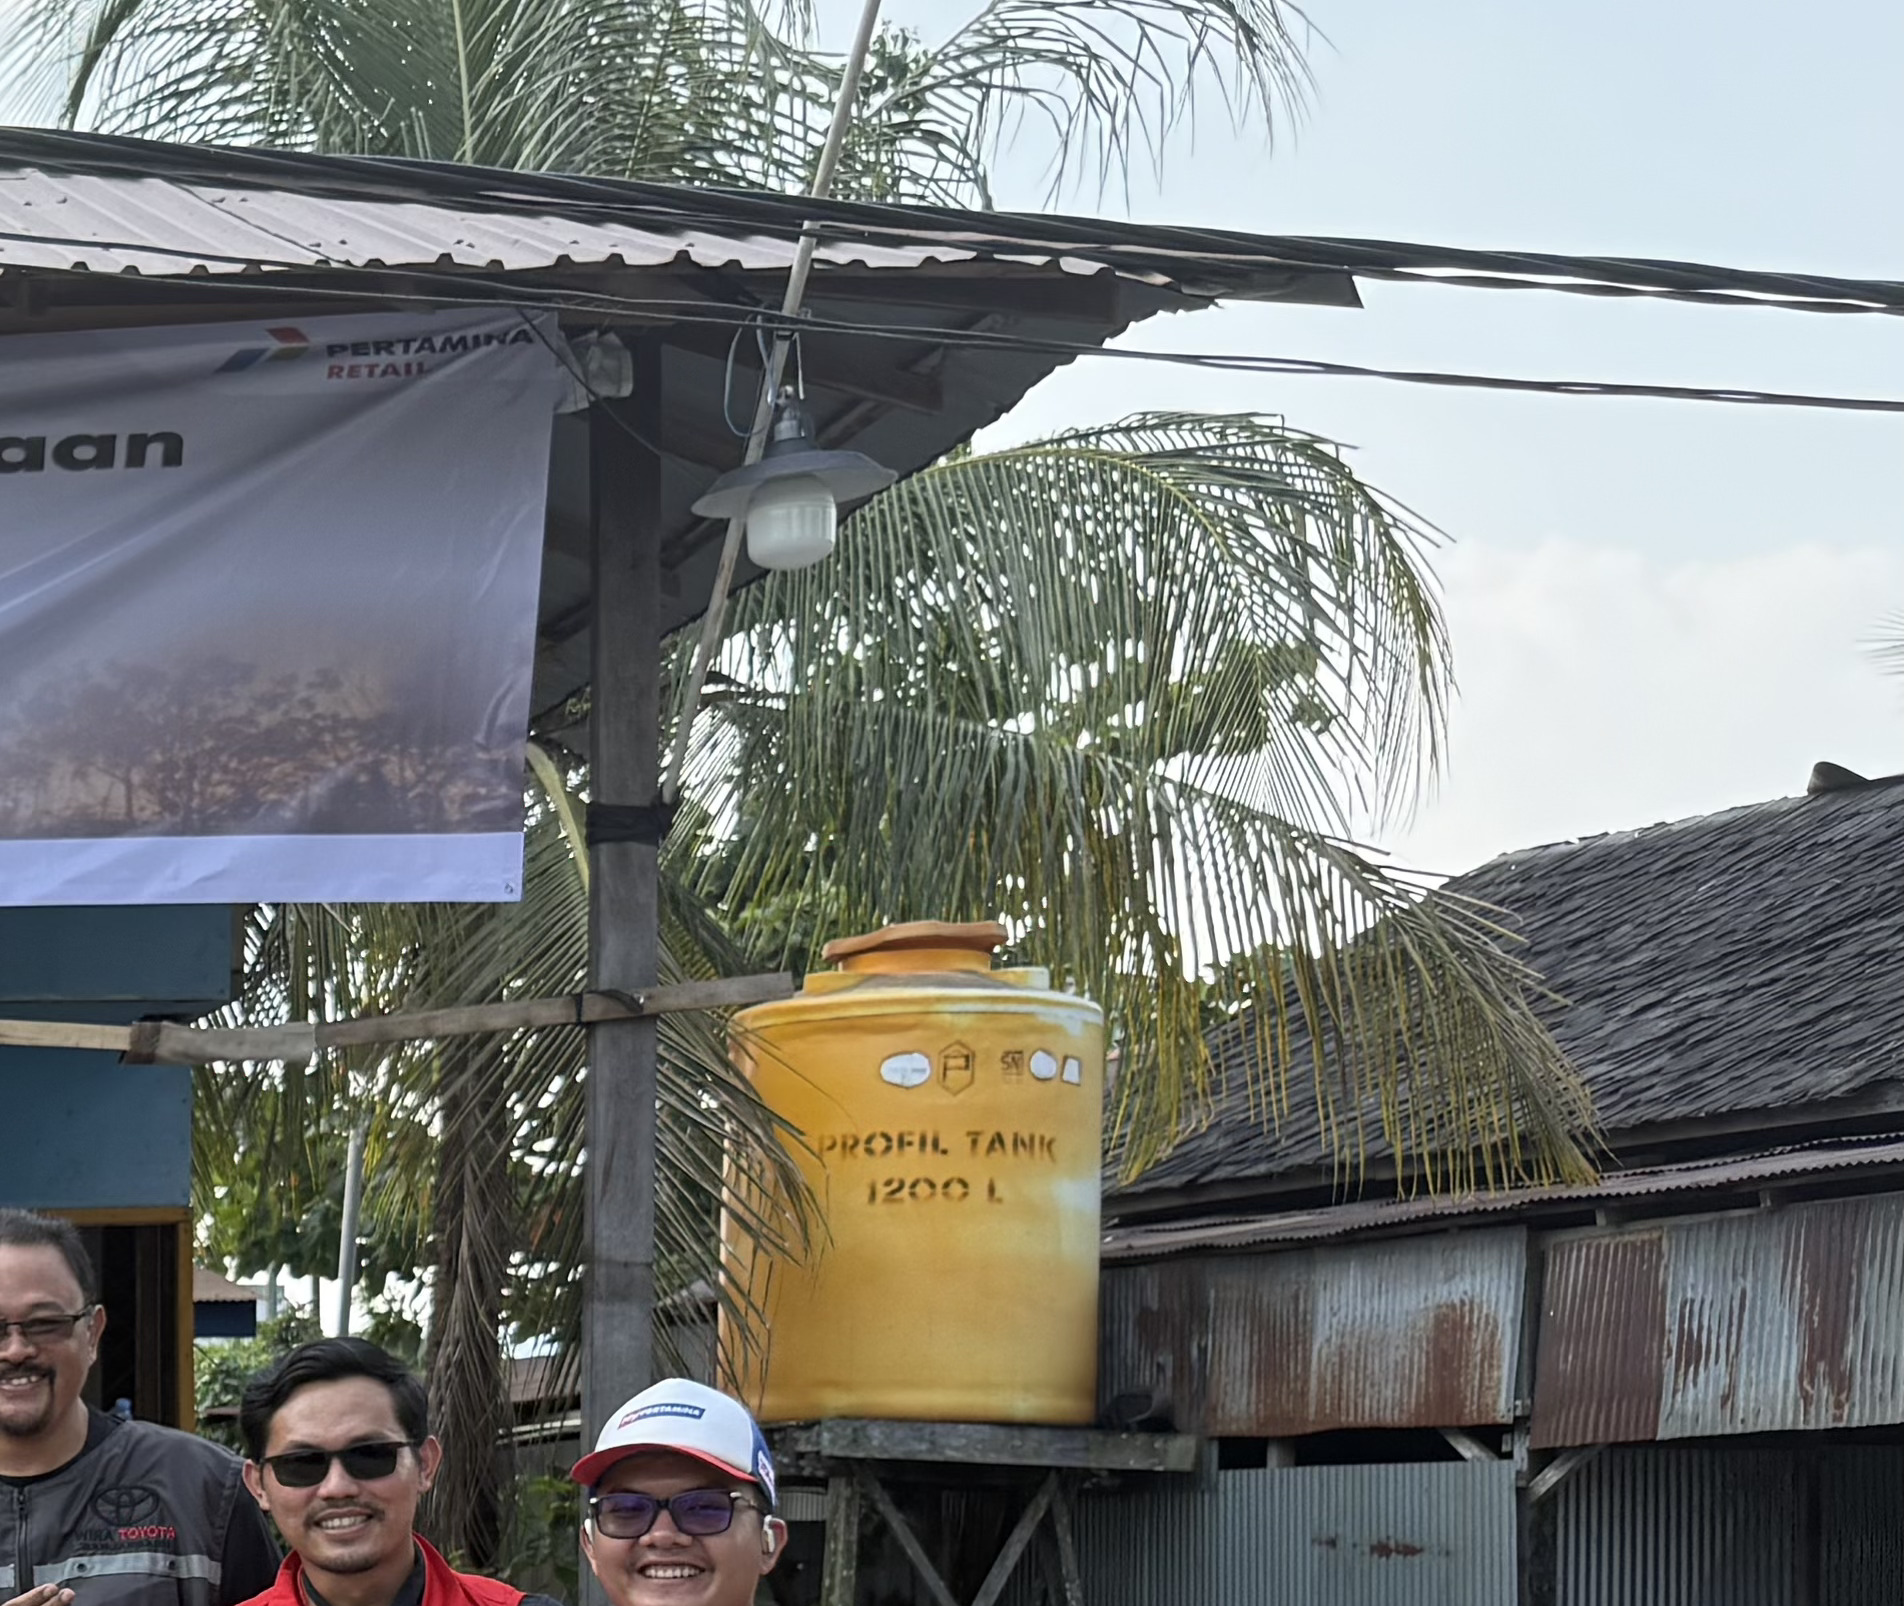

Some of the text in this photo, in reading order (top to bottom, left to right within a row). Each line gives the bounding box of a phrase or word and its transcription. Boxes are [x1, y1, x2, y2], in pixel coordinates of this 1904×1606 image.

[325, 328, 534, 358] PERTAMINA
[325, 361, 426, 380] RETAIL
[818, 1130, 1057, 1163] PROFIL TANK
[867, 1177, 1004, 1205] 1200 L
[116, 1526, 176, 1541] TOYOTA
